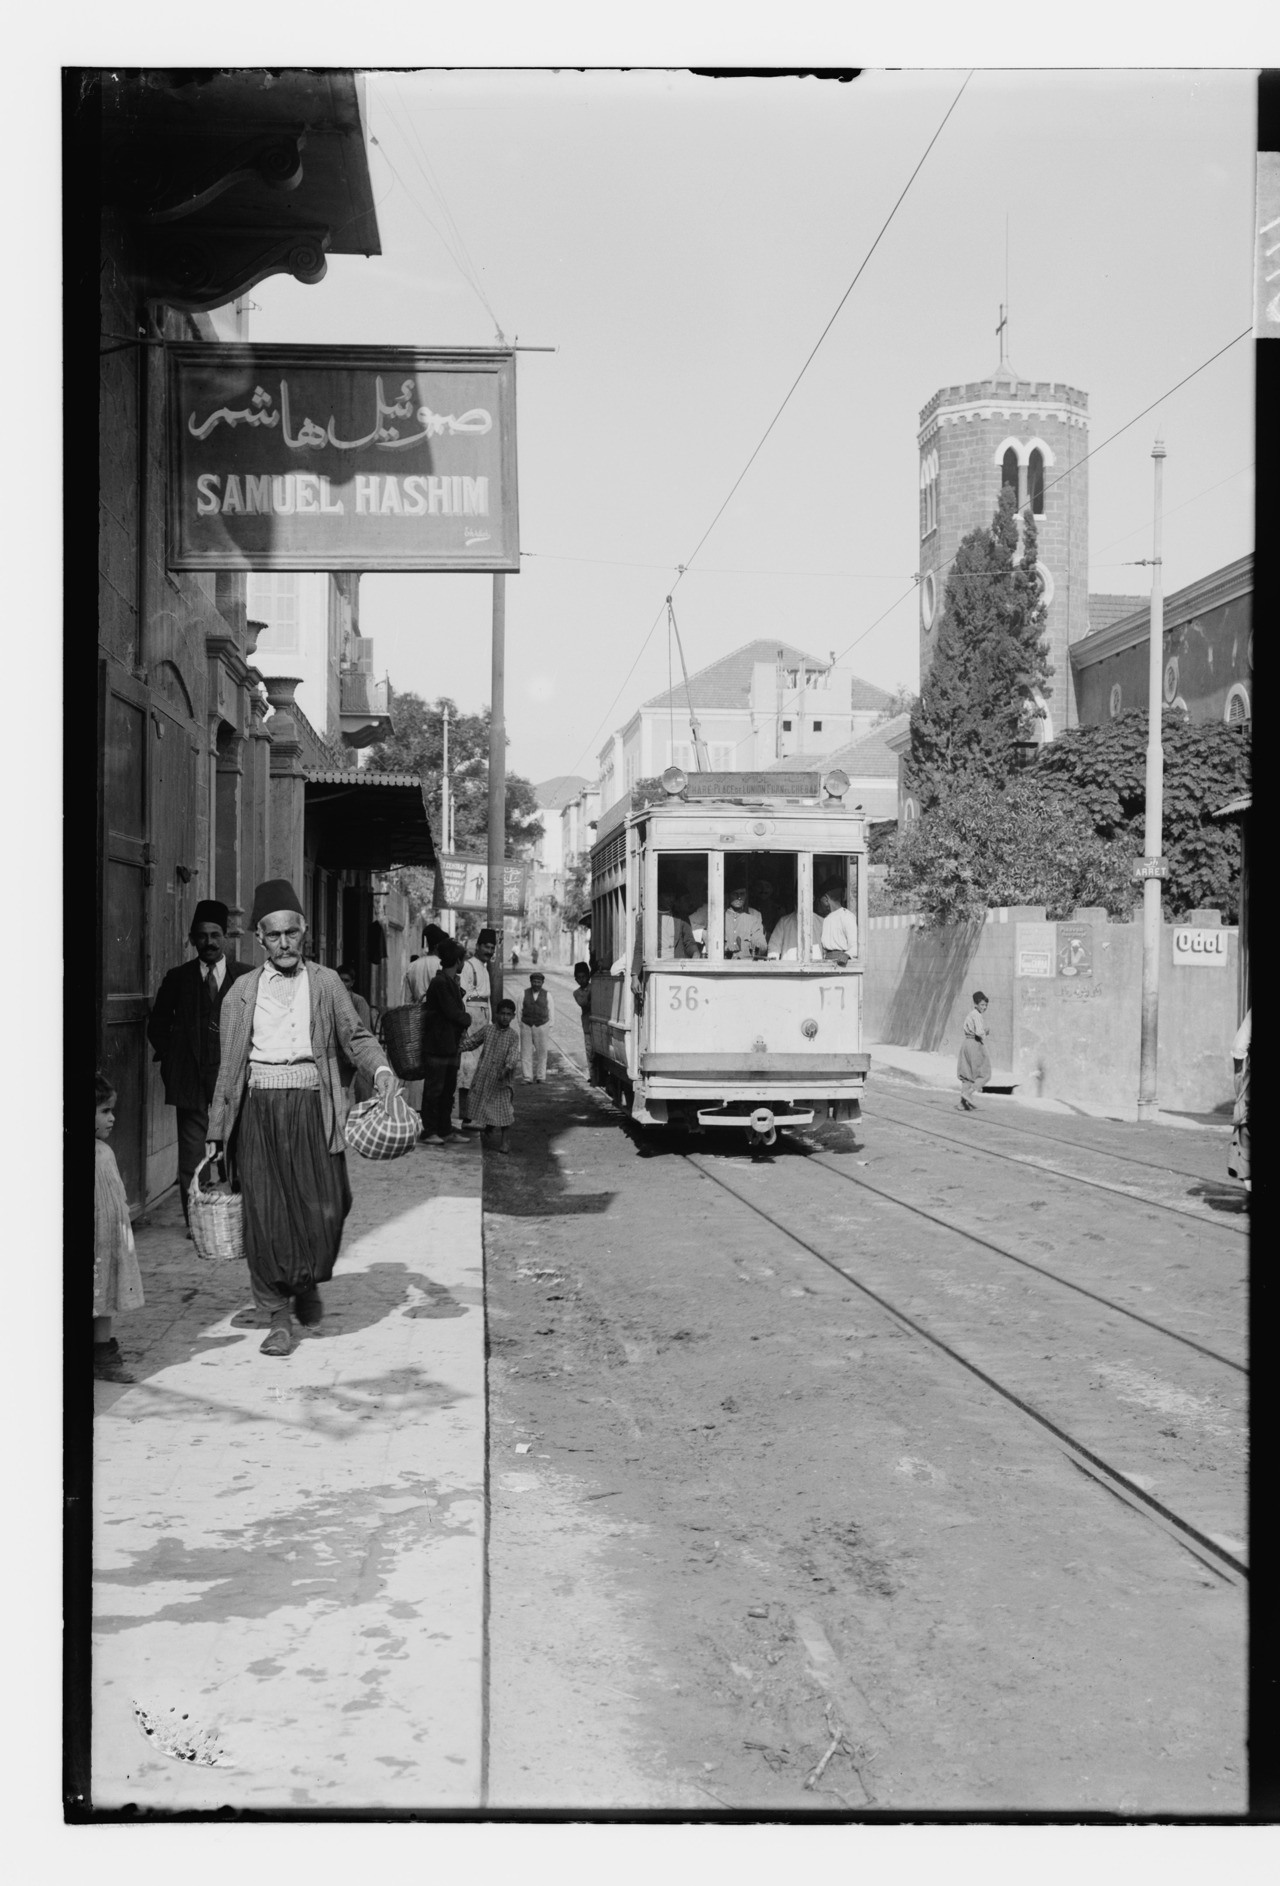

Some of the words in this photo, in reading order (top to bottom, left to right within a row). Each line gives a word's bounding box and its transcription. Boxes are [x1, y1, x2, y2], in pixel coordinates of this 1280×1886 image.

[197, 473, 344, 517] SAMUEL
[355, 474, 490, 518] HASHIM
[1136, 867, 1167, 876] ARRET
[668, 985, 699, 1011] 36
